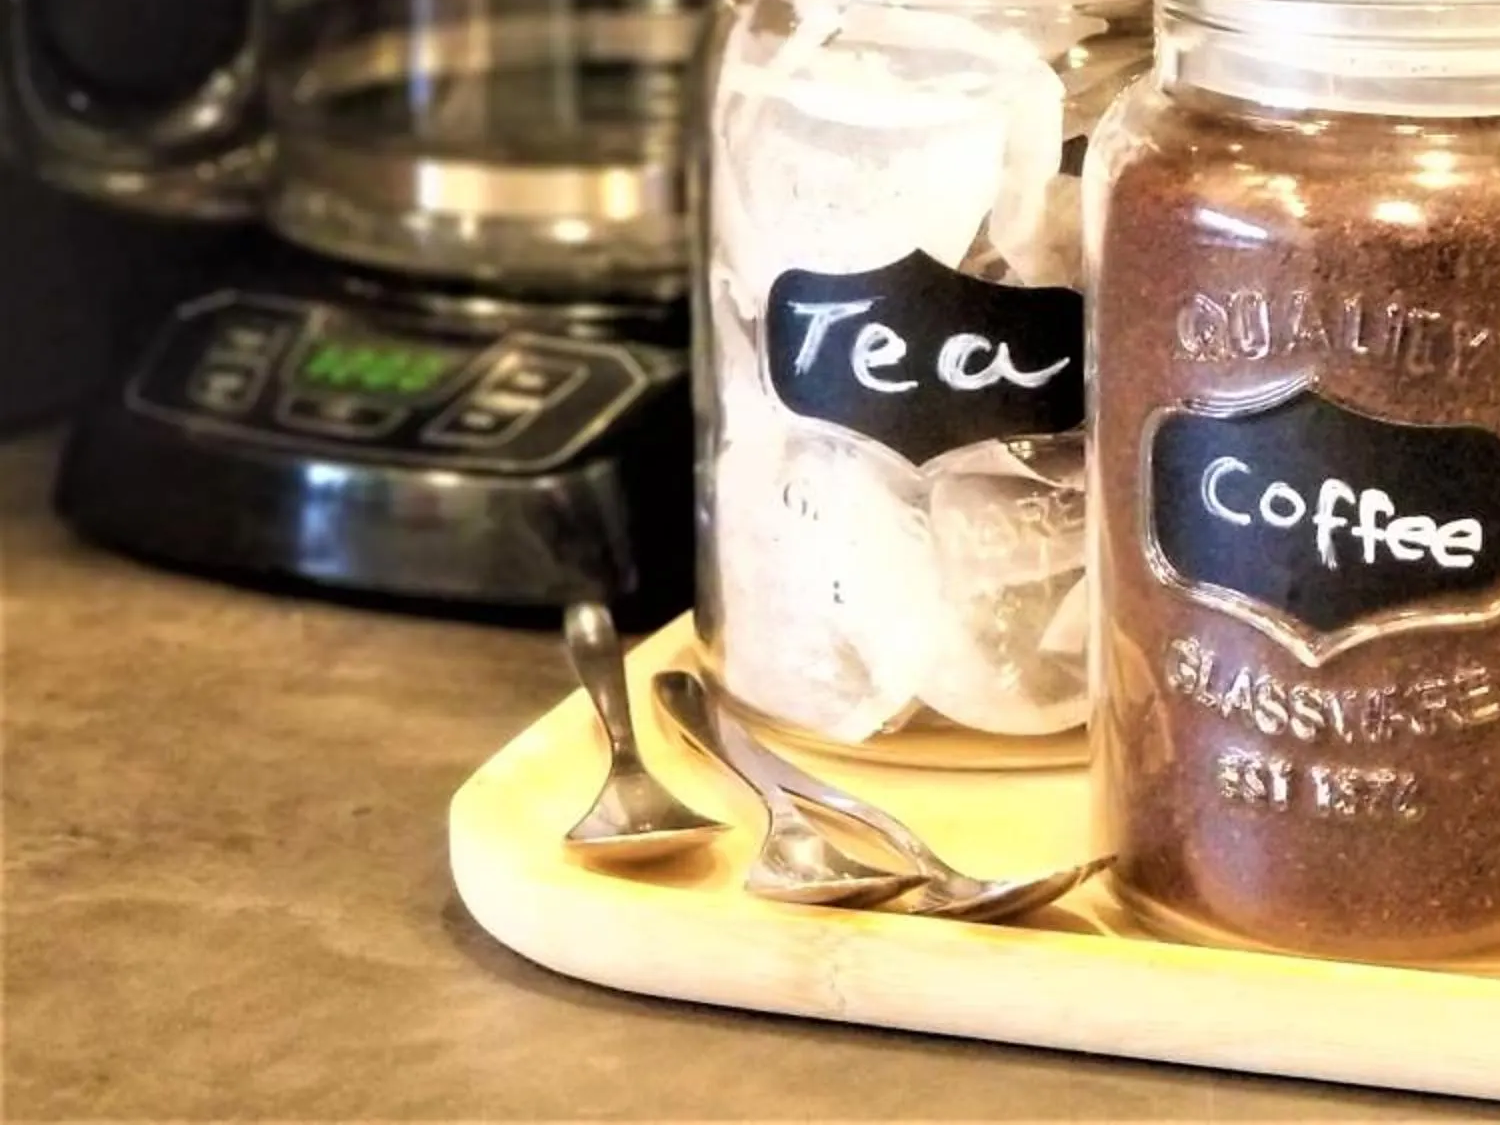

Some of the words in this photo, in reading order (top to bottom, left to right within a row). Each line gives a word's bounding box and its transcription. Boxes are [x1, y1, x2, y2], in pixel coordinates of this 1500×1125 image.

[787, 295, 1071, 393] Tea
[1174, 289, 1489, 374] QUALITY
[1202, 456, 1483, 571] Coffee
